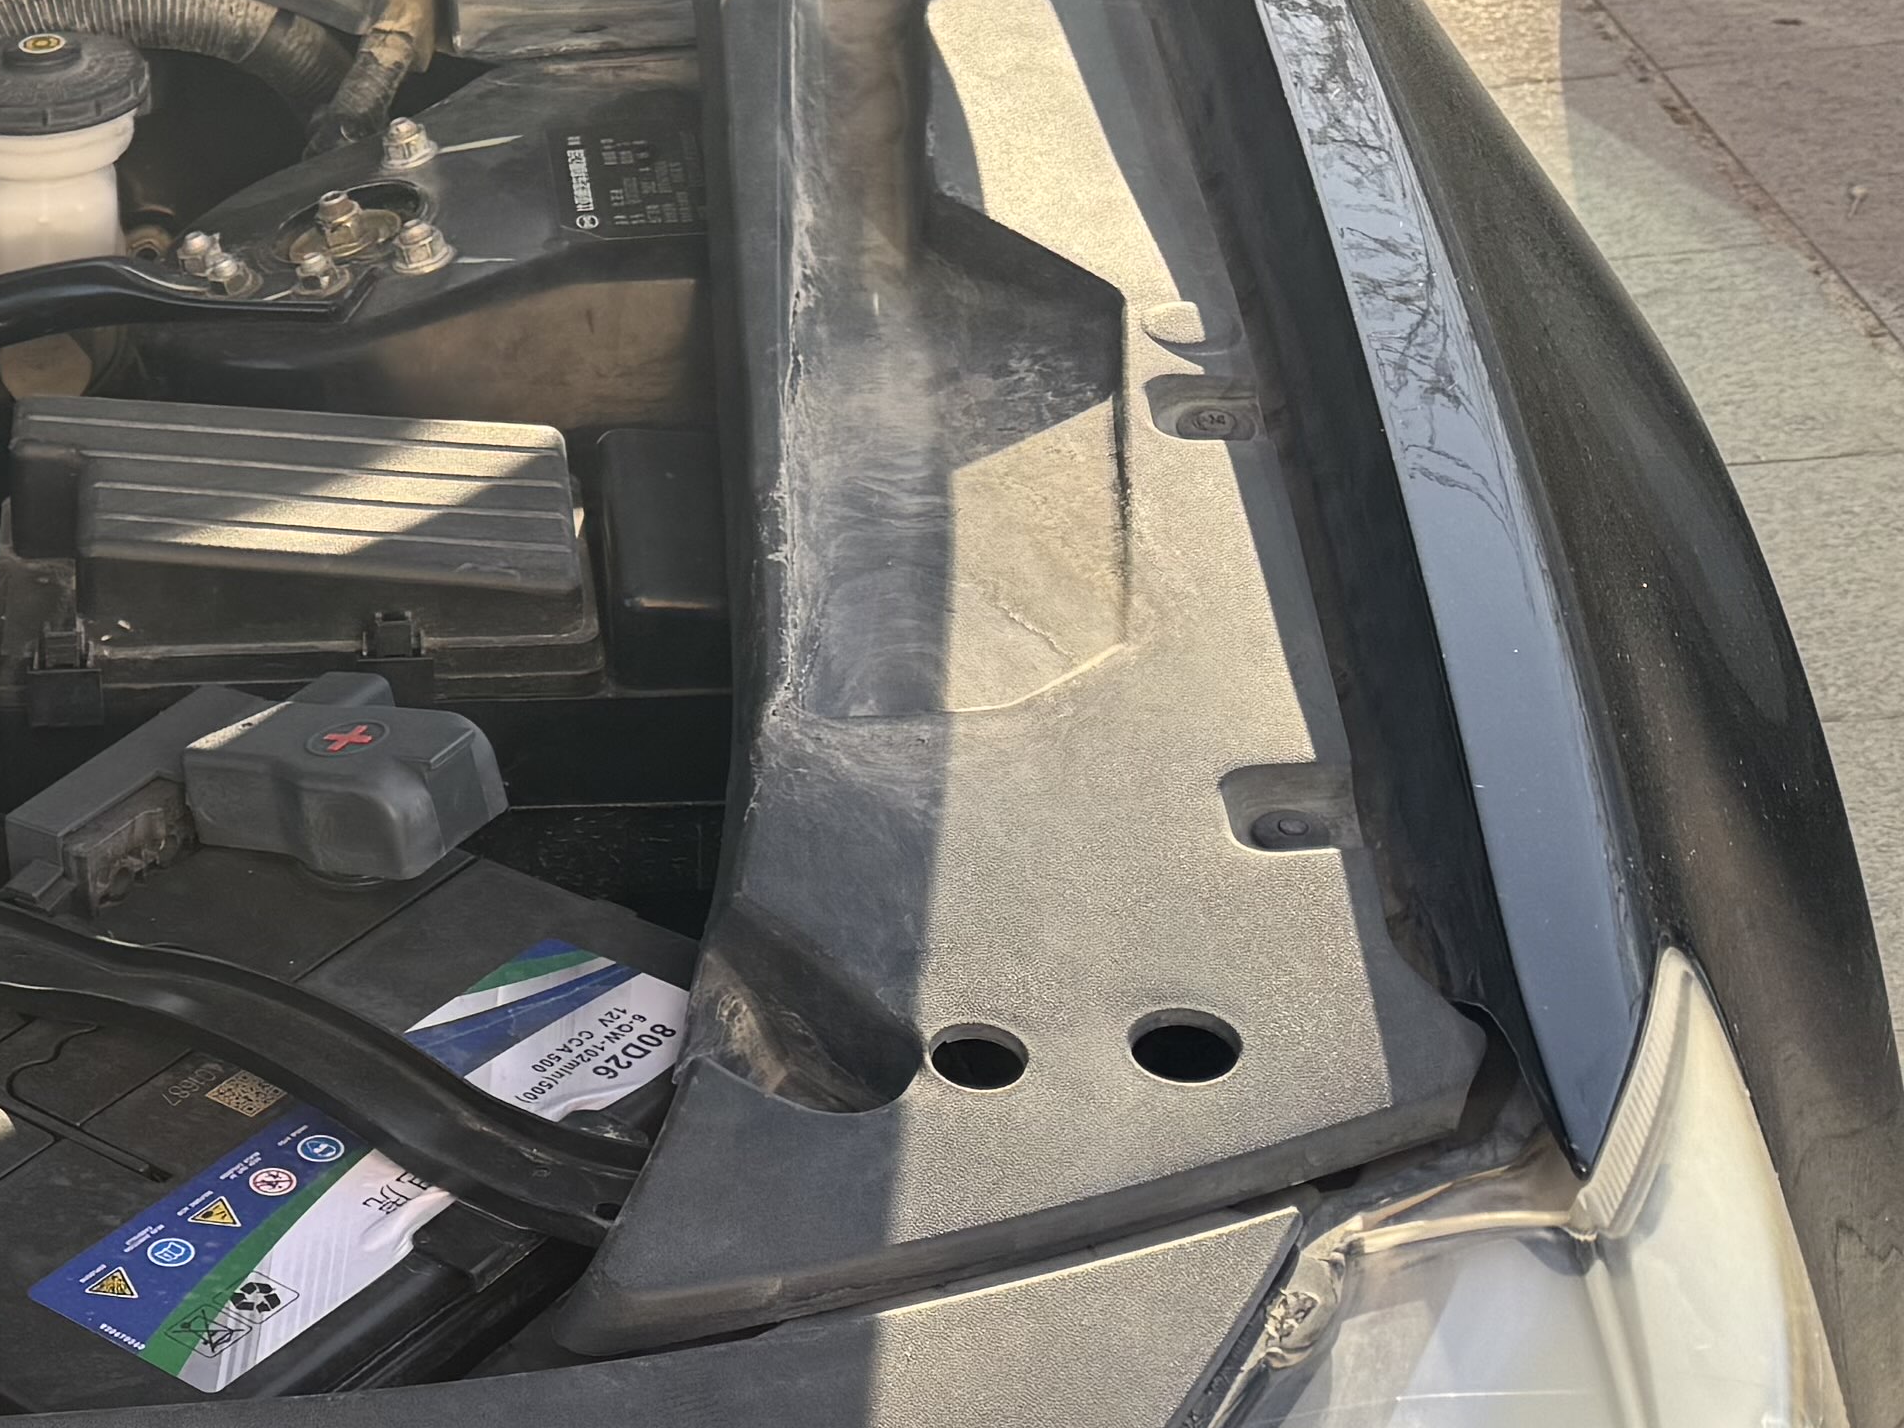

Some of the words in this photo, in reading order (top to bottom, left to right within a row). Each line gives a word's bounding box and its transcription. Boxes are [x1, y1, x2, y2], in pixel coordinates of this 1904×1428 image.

[598, 1007, 627, 1027] 12V
[556, 1030, 594, 1054] CCA
[592, 1024, 677, 1079] 80D26
[531, 1053, 562, 1073] 500
